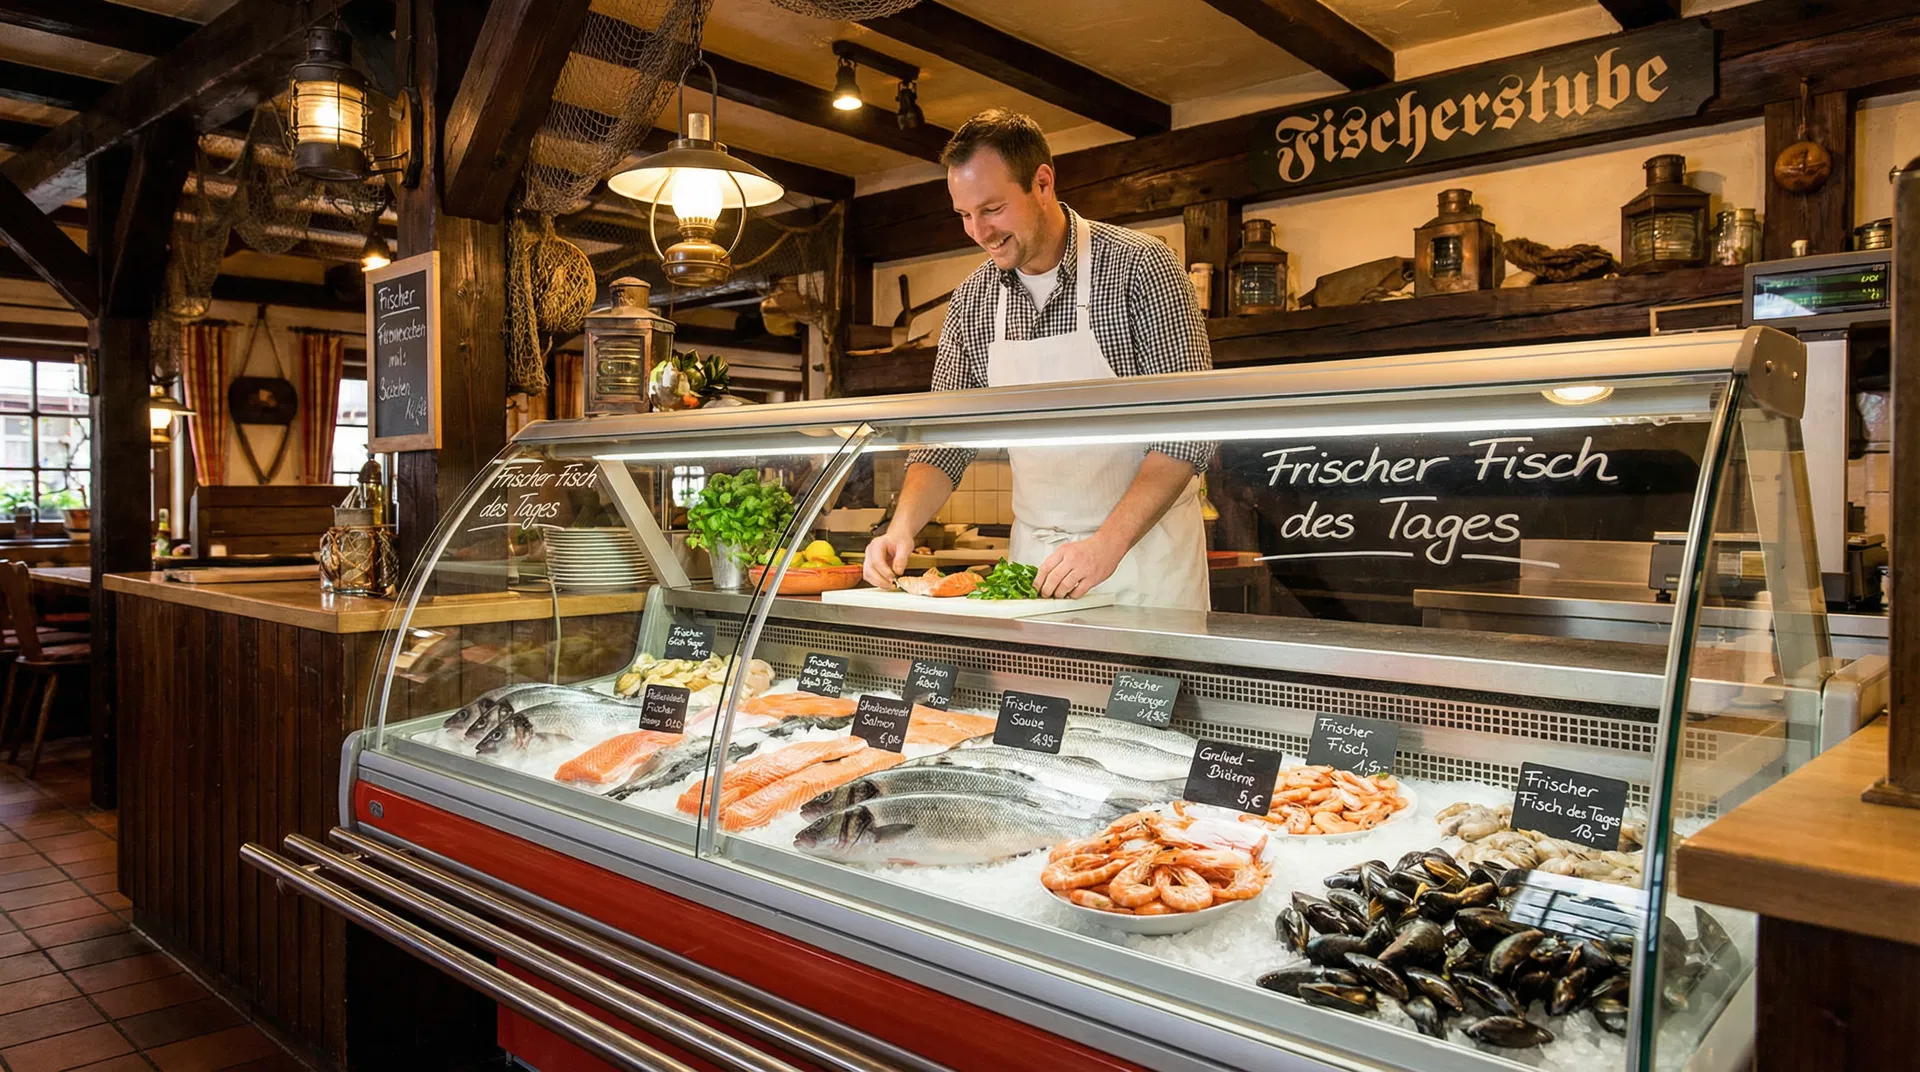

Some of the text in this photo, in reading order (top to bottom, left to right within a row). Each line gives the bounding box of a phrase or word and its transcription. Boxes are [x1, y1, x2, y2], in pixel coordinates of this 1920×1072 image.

[1275, 46, 1669, 183] Fischerstube
[1262, 436, 1619, 486] Frischer Fisch
[492, 463, 599, 488] Frischer Fisch
[479, 493, 560, 530] des Tages
[1281, 496, 1521, 565] des Tages
[1119, 675, 1163, 691] Frischer
[1005, 696, 1048, 713] Frischer
[1319, 718, 1374, 738] Frischer
[1326, 737, 1369, 758] Fisch
[1524, 770, 1599, 798] Frischer
[1237, 790, 1264, 810] 5,€
[1518, 791, 1621, 831] Fisch des Tages
